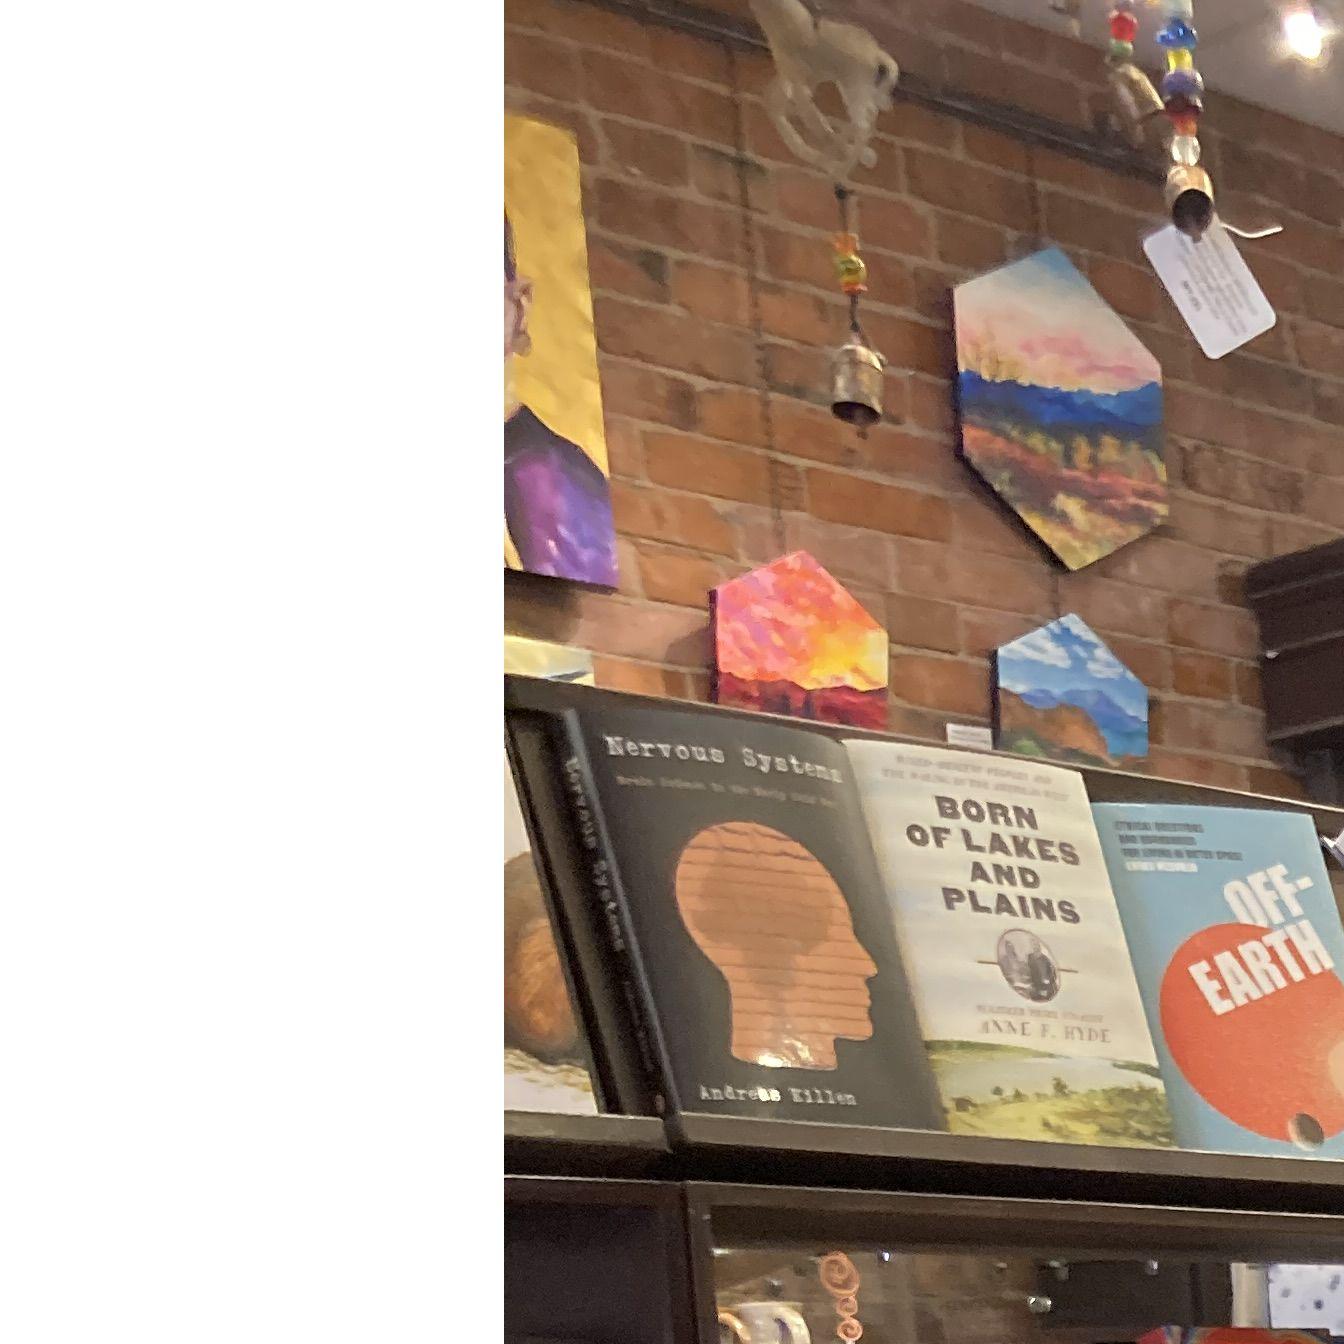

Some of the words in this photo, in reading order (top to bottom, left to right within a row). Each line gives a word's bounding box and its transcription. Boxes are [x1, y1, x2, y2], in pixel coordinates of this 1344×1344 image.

[603, 734, 725, 764] Nervous
[742, 747, 843, 783] Systems
[935, 795, 1039, 830] BORN
[905, 823, 951, 849] OF
[961, 828, 1081, 866] LAKES
[971, 860, 1041, 889] AND
[1223, 863, 1313, 928] OFF-
[941, 886, 1081, 925] PLAINS
[1187, 919, 1334, 1016] EARTH
